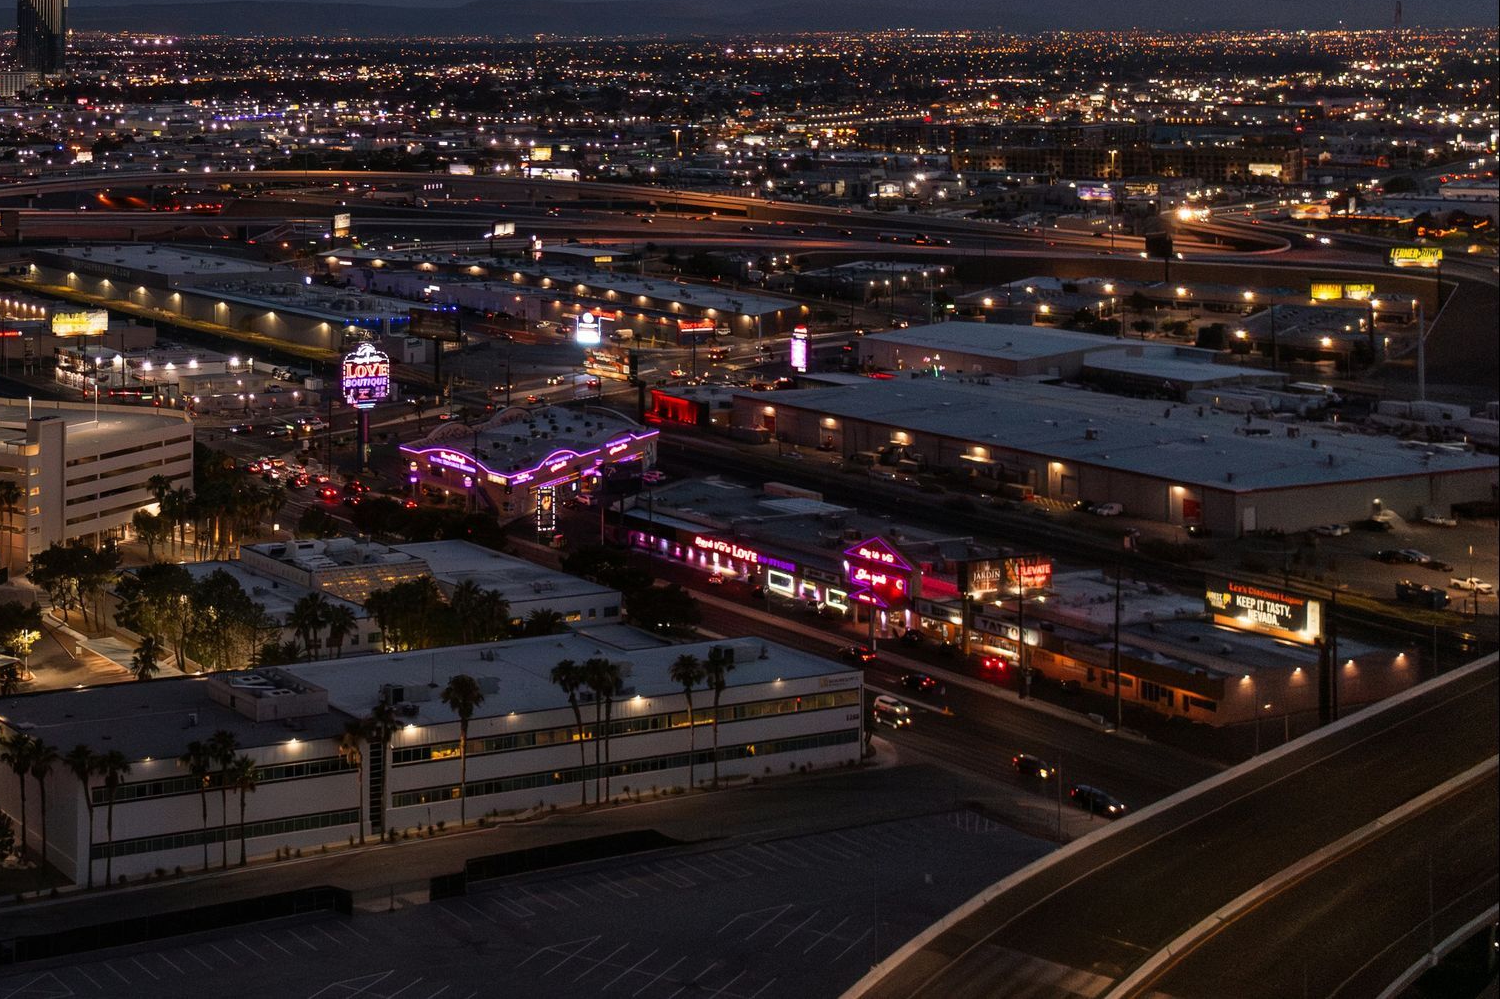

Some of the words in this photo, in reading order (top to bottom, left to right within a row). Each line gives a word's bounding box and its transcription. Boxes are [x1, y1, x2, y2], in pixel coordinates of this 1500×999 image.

[345, 362, 389, 379] LOVE
[345, 377, 388, 388] BOUTIQUE
[732, 544, 758, 563] LOVE
[973, 569, 1001, 582] JARDIN
[1236, 594, 1256, 611] KEEP
[1256, 599, 1265, 612] IT
[1266, 601, 1292, 619] TASTY,
[1247, 609, 1280, 627] NEVADA.
